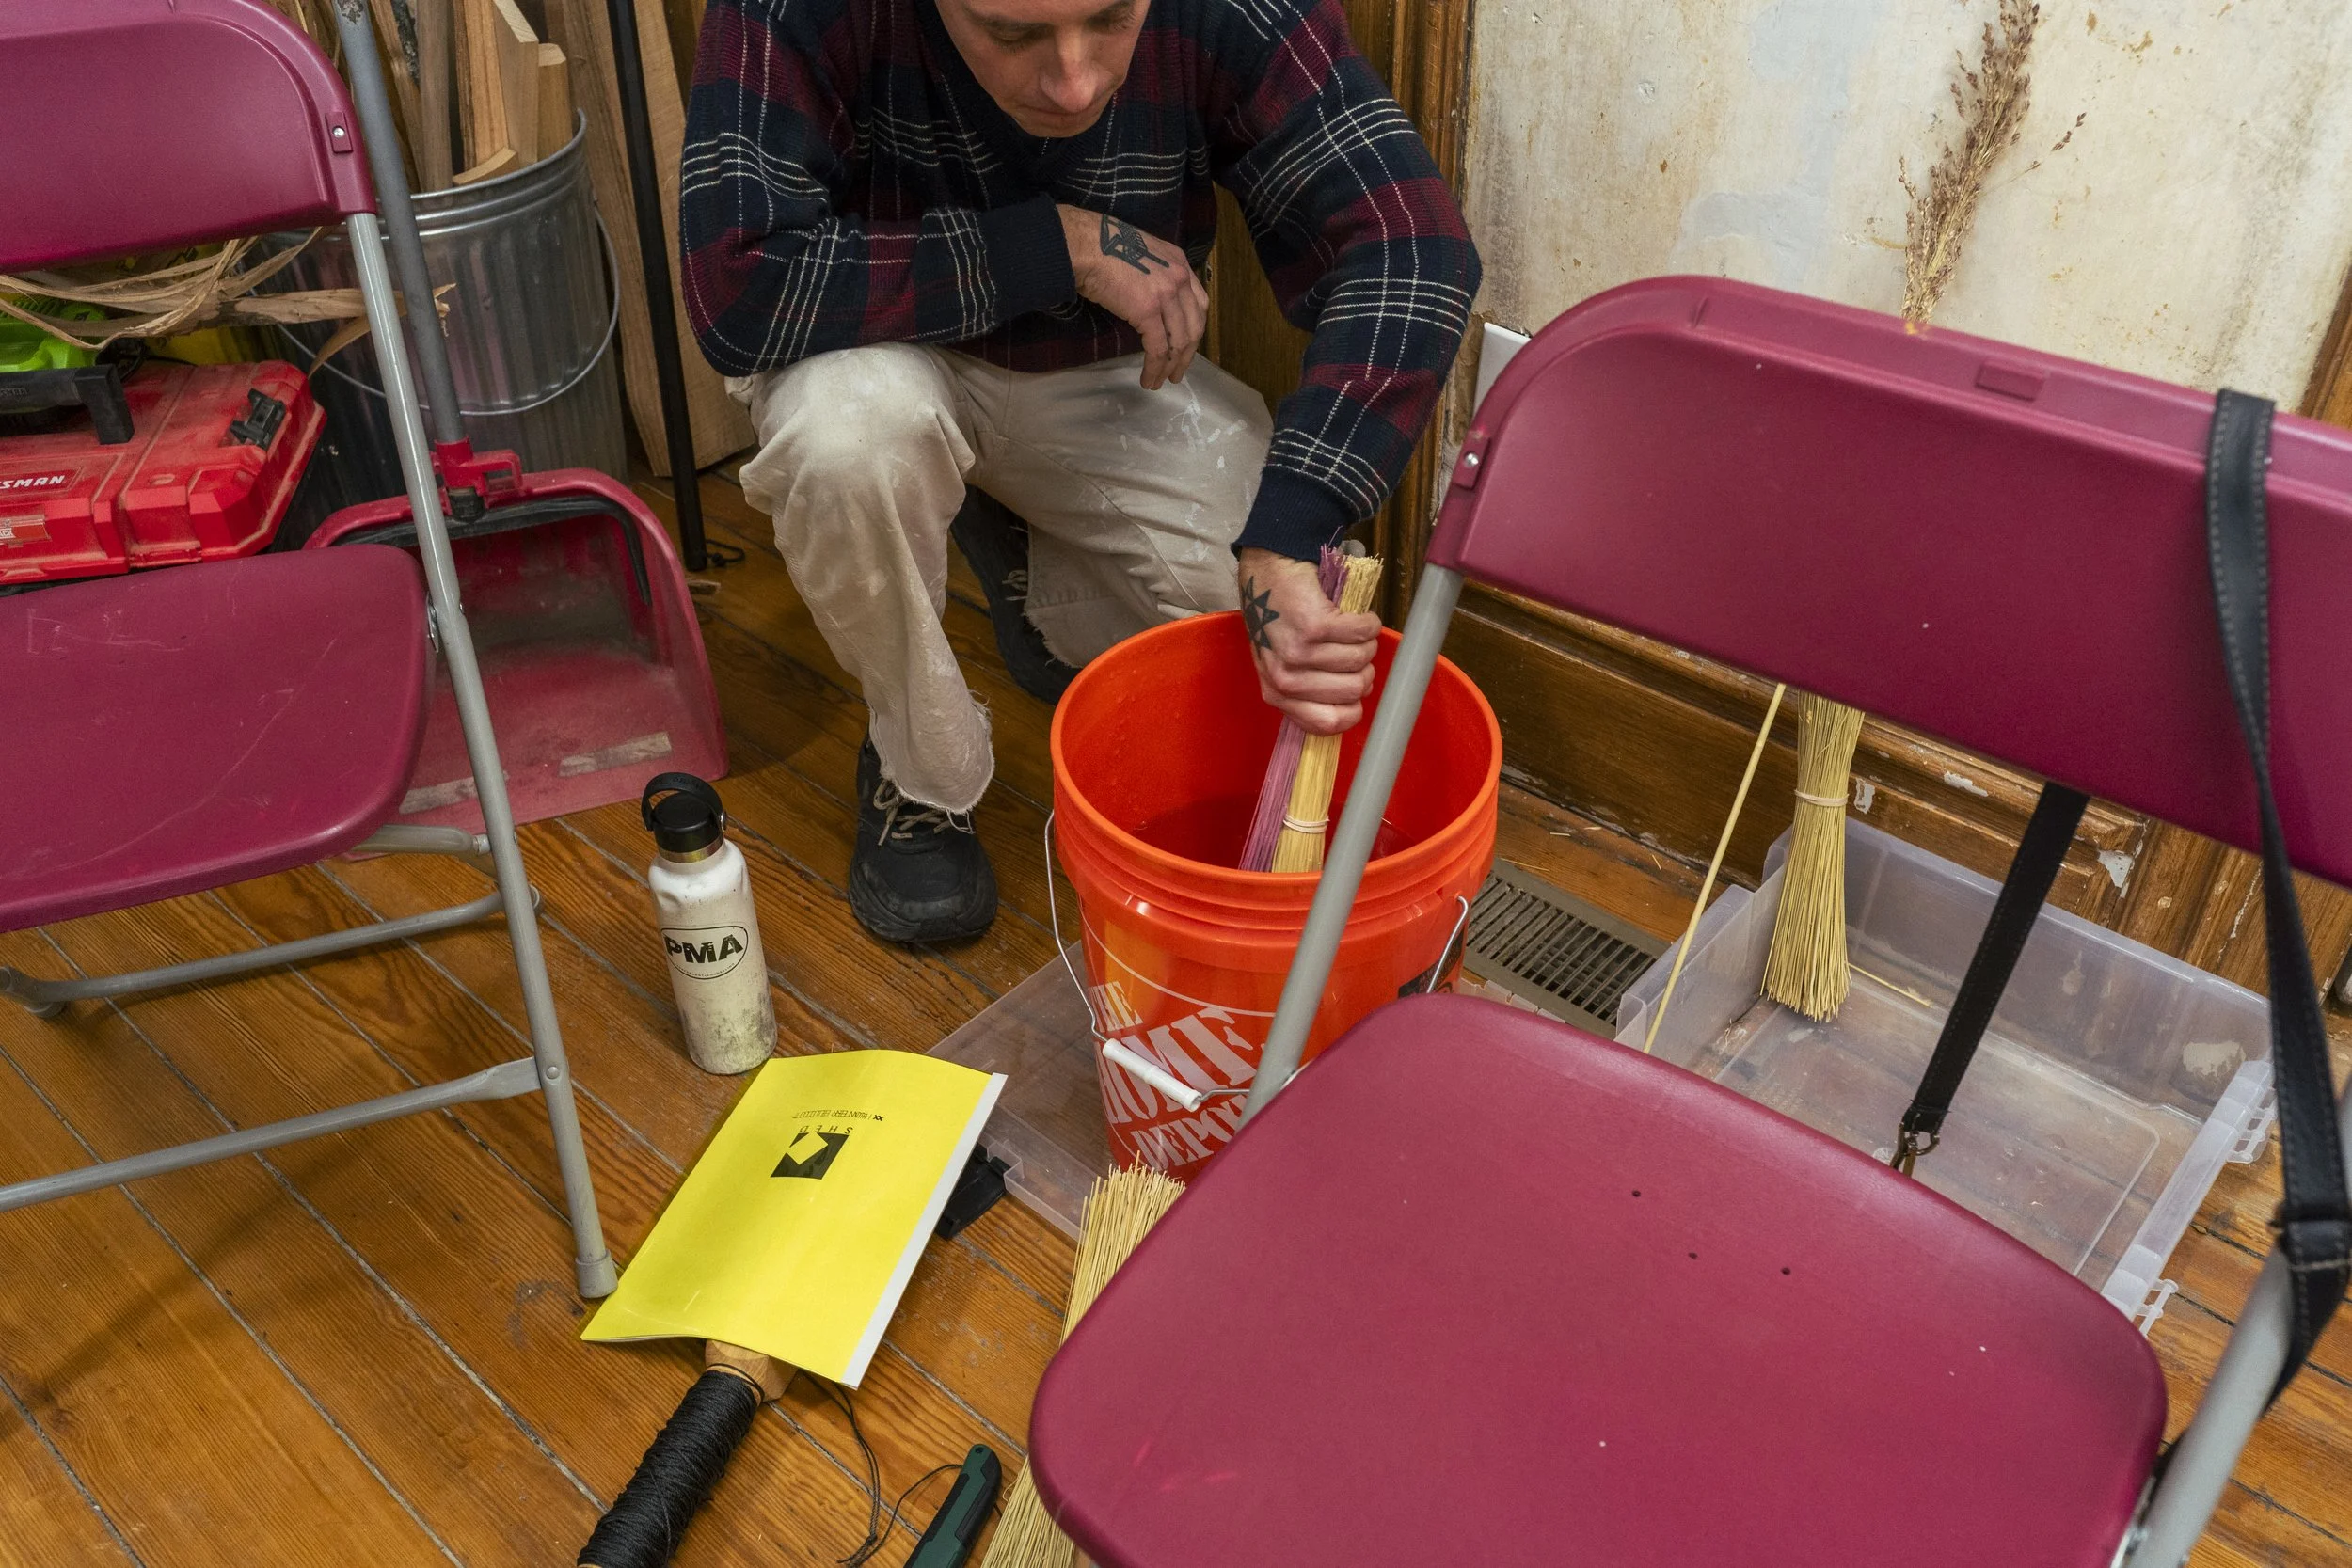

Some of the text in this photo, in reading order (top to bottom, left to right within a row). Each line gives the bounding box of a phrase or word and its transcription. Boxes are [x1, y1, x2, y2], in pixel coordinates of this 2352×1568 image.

[663, 934, 744, 964] PMA
[1089, 981, 1144, 1033] THE
[799, 1125, 853, 1134] SHED
